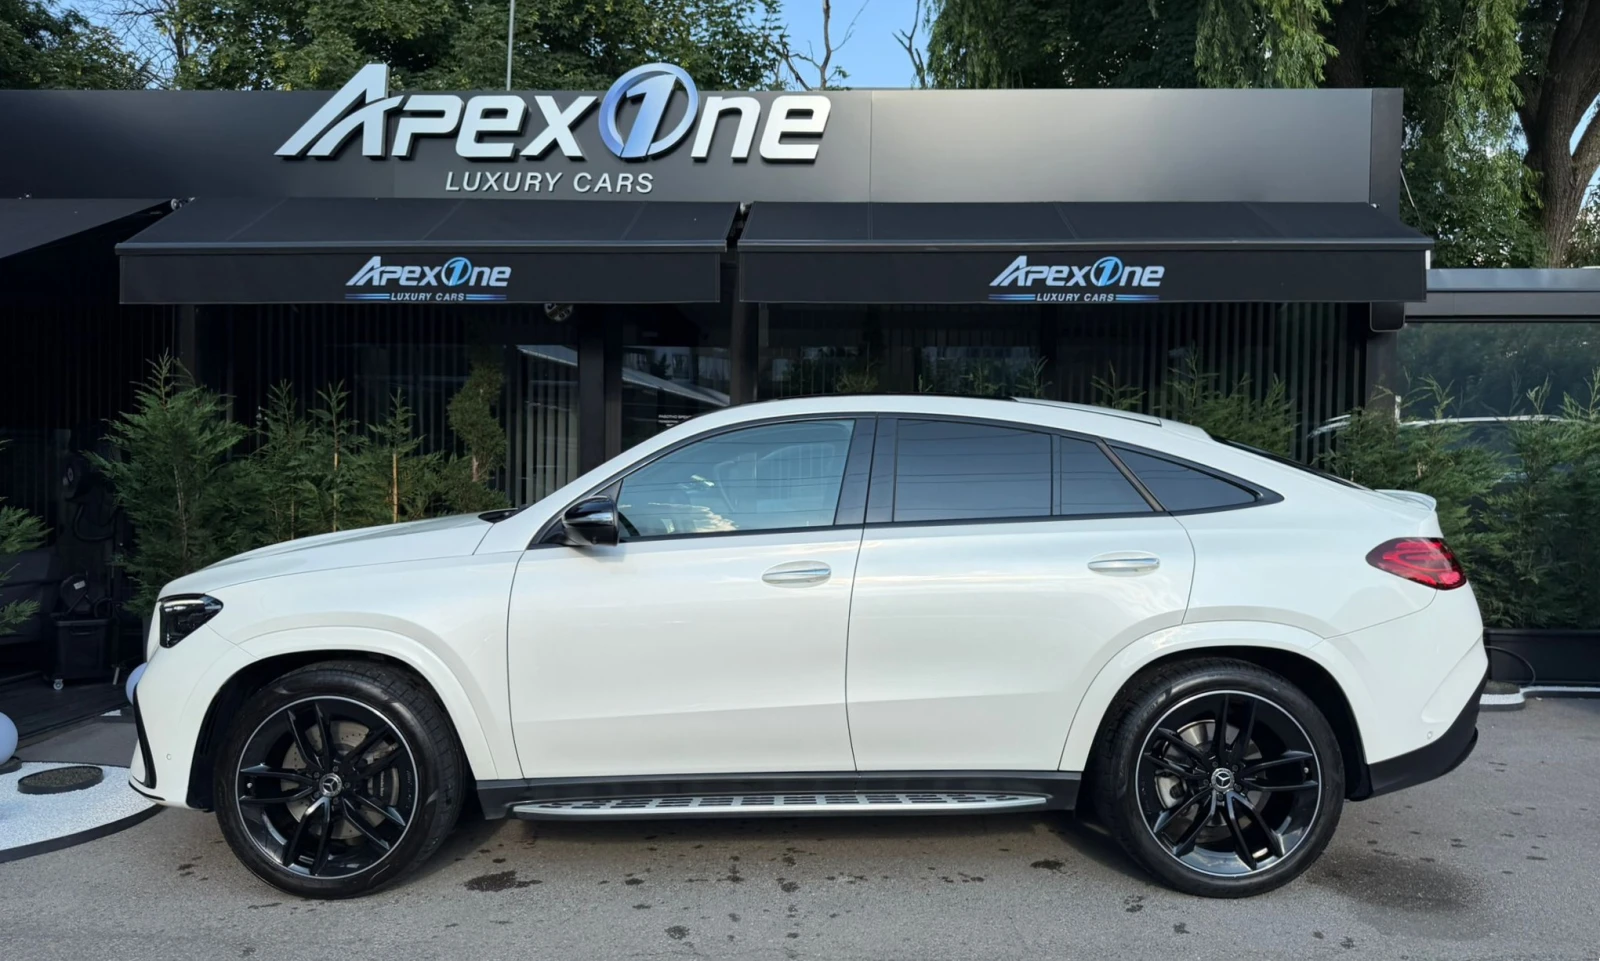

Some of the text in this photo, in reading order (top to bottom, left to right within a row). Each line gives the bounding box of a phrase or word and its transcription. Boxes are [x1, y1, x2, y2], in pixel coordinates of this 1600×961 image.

[445, 171, 654, 193] LUXURY CARS
[391, 292, 465, 301] LUXURY CARS
[1036, 293, 1114, 302] LUXURY CARS
